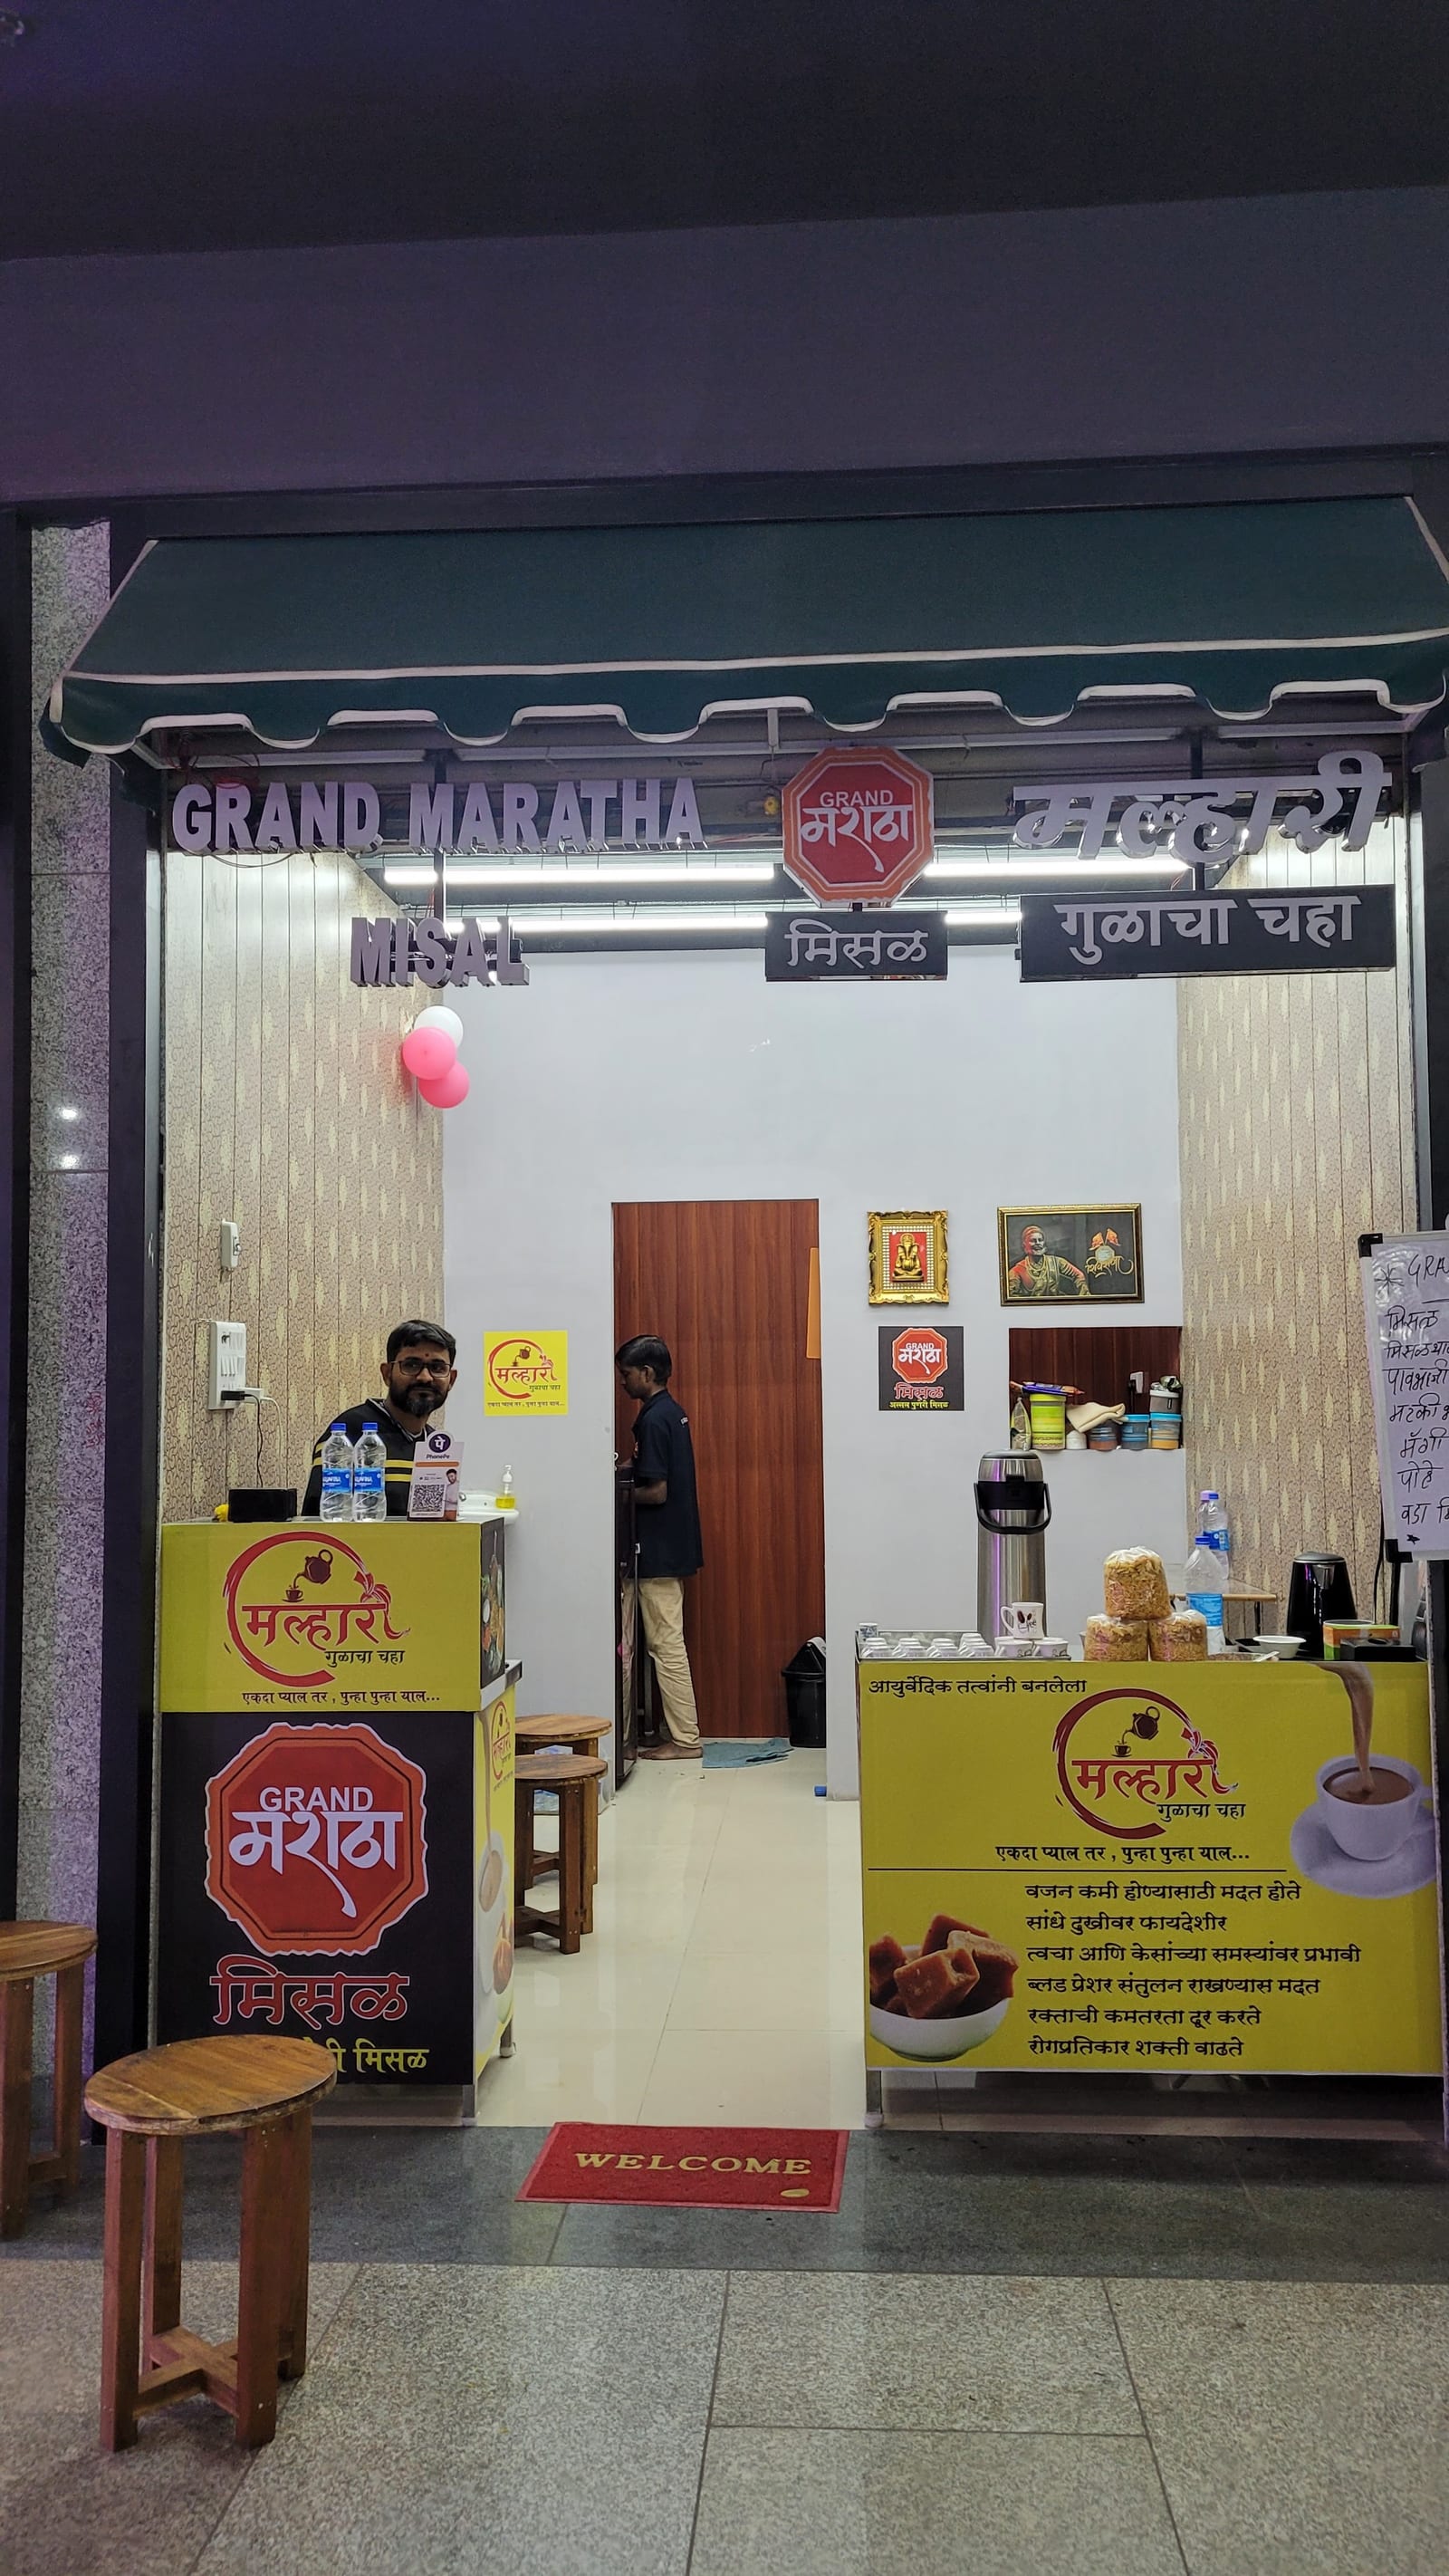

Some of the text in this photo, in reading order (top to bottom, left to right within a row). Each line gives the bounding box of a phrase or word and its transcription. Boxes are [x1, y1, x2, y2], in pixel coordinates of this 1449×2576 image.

[820, 790, 894, 808] GRAND
[1012, 750, 1393, 870] मल्हारी
[172, 777, 710, 854] GRAND MARATHA
[800, 804, 914, 873] मराठा
[783, 918, 929, 969] मिसळ
[1054, 895, 1361, 966] गुळाचा चहा
[350, 916, 530, 988] MISAL
[897, 1348, 942, 1375] मराठा
[894, 1381, 945, 1401] मिसळ
[434, 1436, 446, 1451] पे
[242, 1585, 410, 1651] मल्हारी
[324, 1649, 405, 1668] गुळाचा चहा
[242, 1692, 274, 1705] एकदा
[277, 1692, 308, 1704] प्याल
[311, 1692, 328, 1704] तर
[340, 1691, 367, 1706] पुन्हा
[370, 1691, 397, 1706] पुन्हा
[868, 1674, 1088, 1698] आयुर्वेदिक तत्वांनी बनलेला
[1071, 1741, 1238, 1804] मल्हारी
[258, 1786, 374, 1812] GRAND
[1156, 1803, 1246, 1822] गुळाचा चहा
[227, 1812, 404, 1919] मराठा
[995, 1846, 1038, 1862] एकदा
[1041, 1846, 1080, 1861] प्याल
[1083, 1846, 1106, 1861] तर
[1120, 1846, 1156, 1865] पुन्हा
[1159, 1846, 1195, 1865] पुन्हा
[1024, 1880, 1302, 1902] वजन कमी होण्यासाठी मदत होते
[1026, 1908, 1227, 1936] सांधे दुखीवर फायदेशीर
[1026, 1940, 1362, 1963] त्वचा आणि केसांच्या समस्यांवर प्रभावी
[208, 1953, 410, 2032] मिसळ
[1027, 1971, 1321, 1998] ब्लड प्रेशर संतुलन राखण्यास मदत
[1028, 2004, 1262, 2029] रक्ताची कमतरता दूर करते
[352, 2037, 430, 2073] मिसळ
[1029, 2034, 1244, 2057] रोगप्रतिकार शक्ती वाढते
[573, 2152, 812, 2176] WELCOME
